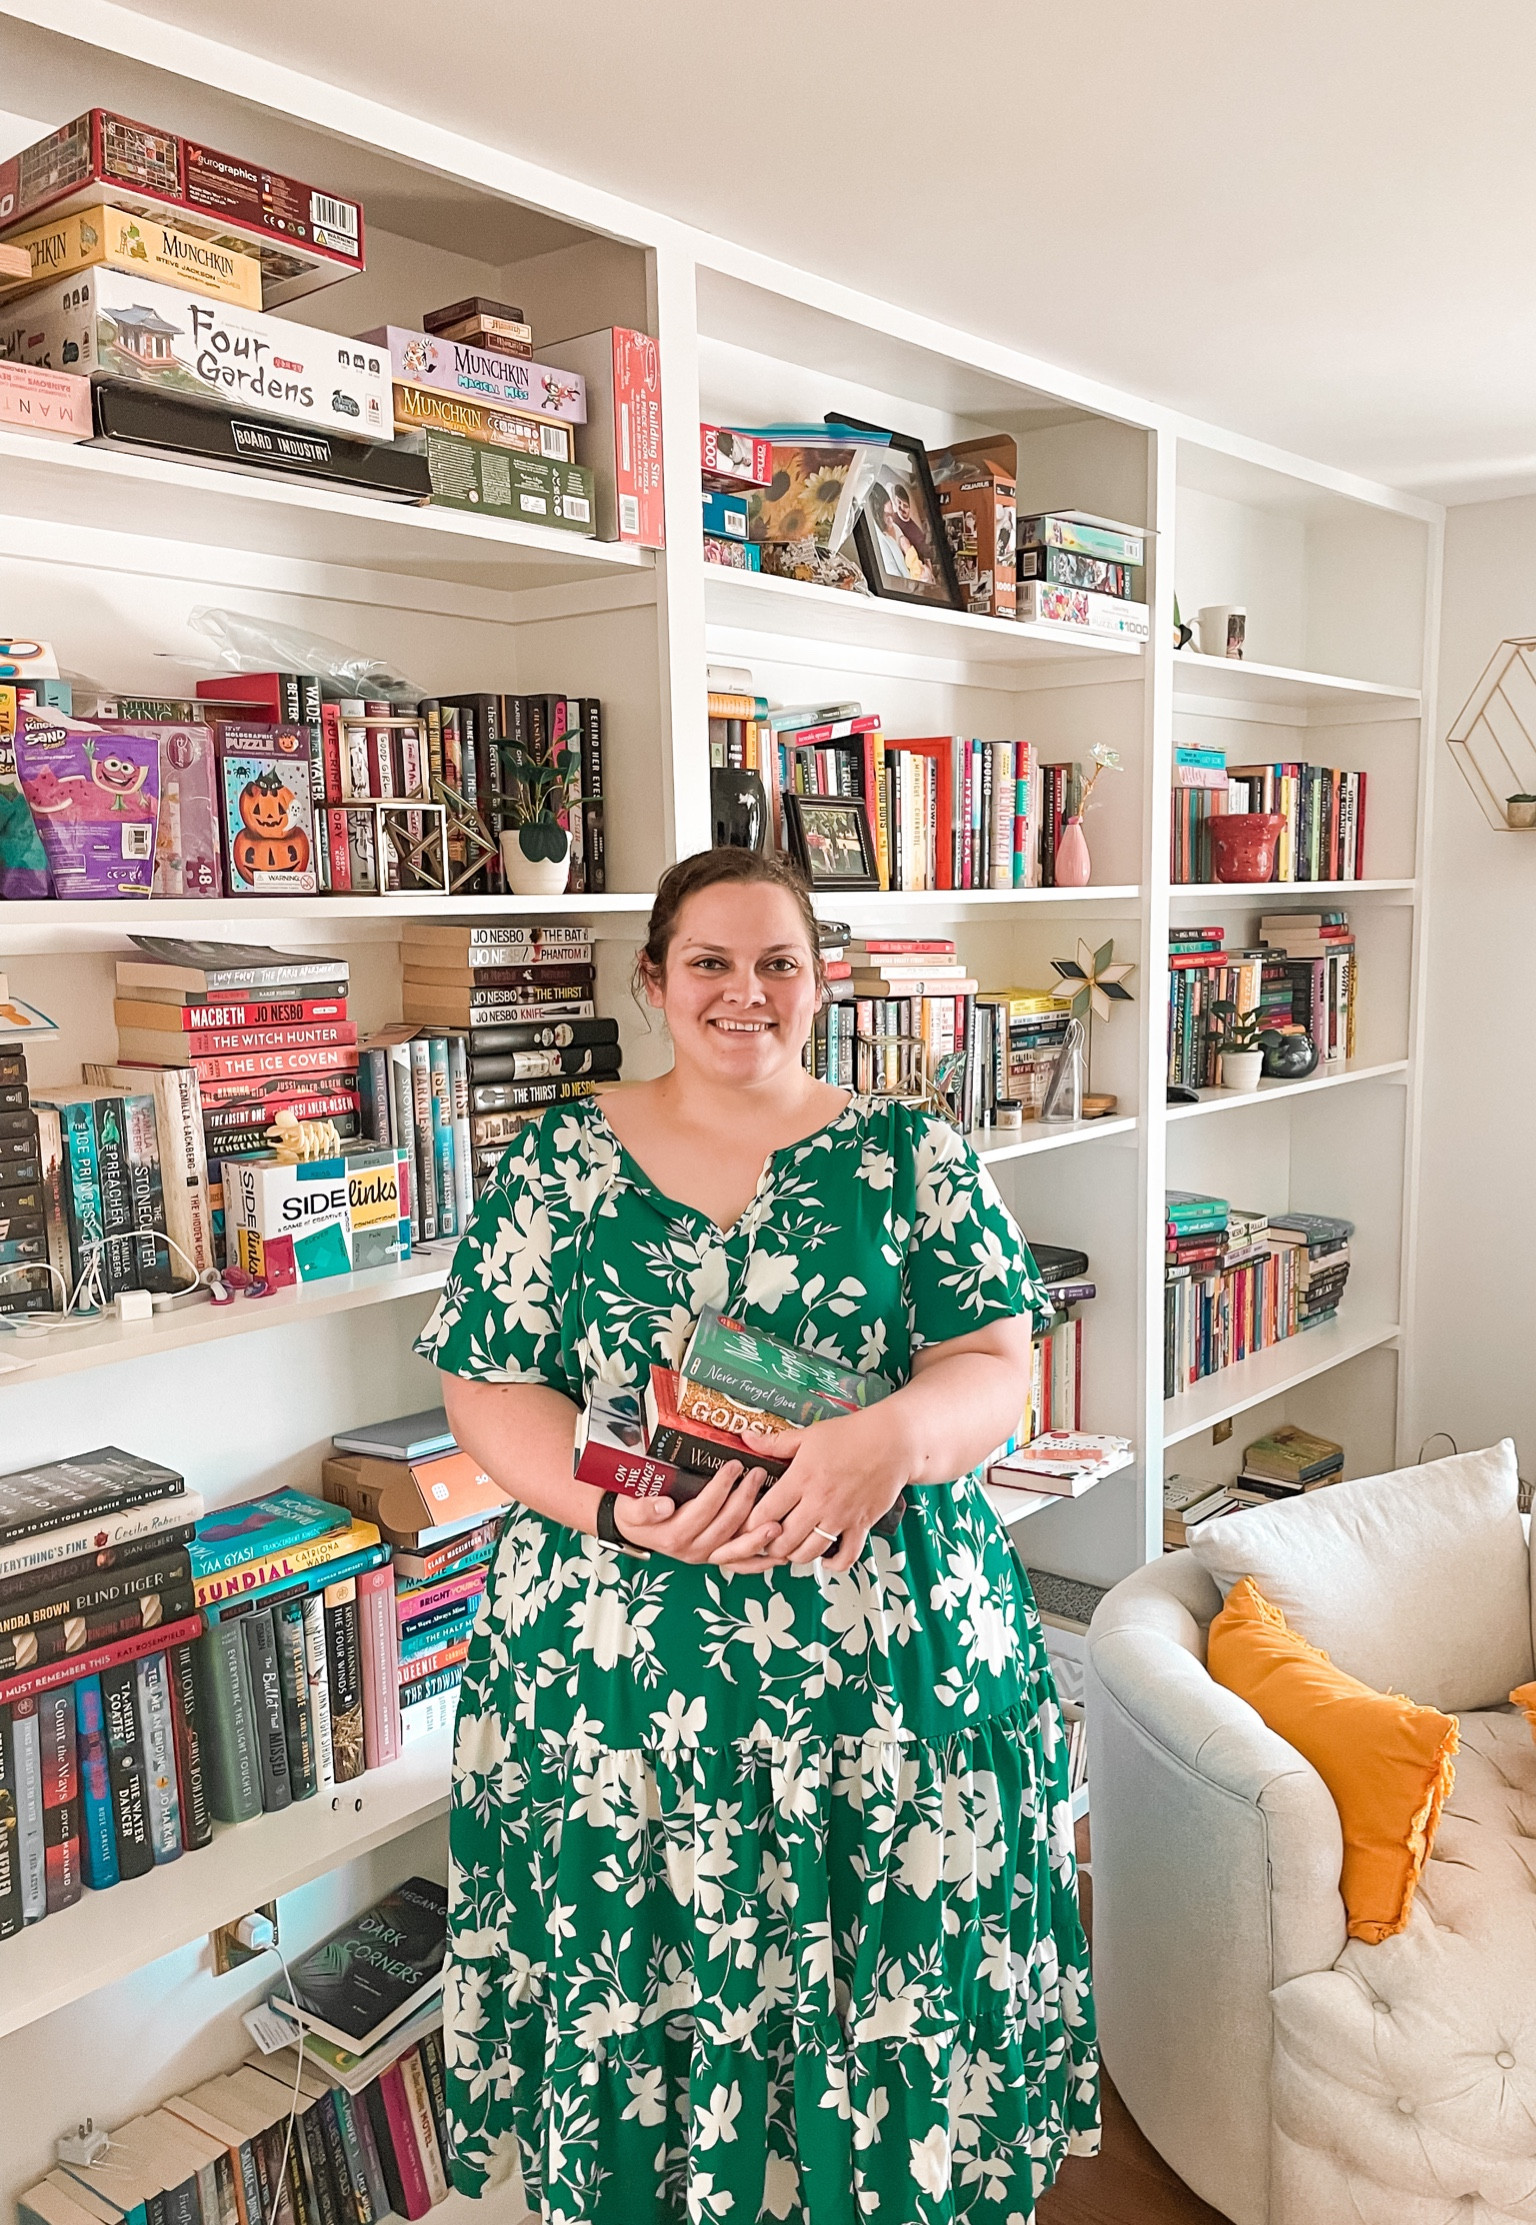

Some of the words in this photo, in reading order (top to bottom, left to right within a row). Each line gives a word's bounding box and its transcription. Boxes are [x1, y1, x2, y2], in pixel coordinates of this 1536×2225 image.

[156, 256, 180, 268] STEVE
[182, 264, 216, 281] JACKSON
[162, 230, 234, 277] MUNCHKIN
[187, 304, 270, 362] Four
[197, 350, 314, 407] Gardens
[454, 346, 529, 388] MUNCHKIN
[458, 374, 500, 394] MAGICAL
[403, 387, 482, 431] MUNCHKIN
[236, 429, 272, 450] BOARD
[278, 438, 329, 462] INDUSTRY
[649, 401, 659, 459] Building
[705, 430, 717, 467] 1000
[651, 462, 660, 488] Site
[1125, 622, 1149, 636] 1000
[287, 682, 298, 720] BETTER
[305, 685, 320, 724] WADE
[225, 738, 274, 751] PUZZLE
[326, 711, 336, 746] TRUE
[590, 708, 599, 747] BEHIND
[310, 757, 325, 801] WATER
[329, 750, 340, 791] CRIME
[592, 751, 600, 773] HER
[983, 748, 992, 796] SPOOKED
[592, 775, 601, 799] EYES
[964, 778, 972, 865] HYSTERICAL
[199, 864, 213, 885] 48
[474, 930, 488, 943] JO
[543, 929, 562, 942] THE
[564, 928, 582, 941] BAT
[472, 948, 489, 965] JO
[541, 947, 582, 960] PHANTOM
[213, 972, 232, 986] LUCY
[260, 969, 275, 983] THE
[473, 992, 487, 1006] JO
[535, 988, 553, 1000] THE
[553, 986, 583, 999] THIRST
[190, 1006, 245, 1027] MACBETH
[254, 1006, 268, 1022] JO
[476, 1010, 488, 1023] JO
[520, 1008, 545, 1020] KNIFE
[212, 1034, 239, 1048] THE
[241, 1030, 283, 1046] WITCH
[287, 1029, 338, 1044] HUNTER
[225, 1059, 255, 1073] THE
[260, 1056, 284, 1070] ICE
[288, 1051, 339, 1067] COVEN
[415, 1067, 428, 1143] DARKNESS
[513, 1087, 529, 1104] THE
[530, 1084, 557, 1101] THIRST
[560, 1083, 571, 1098] JO
[224, 1112, 249, 1125] ABSENT
[251, 1108, 266, 1122] ONE
[485, 1121, 501, 1139] The
[76, 1131, 90, 1154] ICE
[178, 1083, 189, 1119] CAMILLA
[194, 1213, 203, 1241] HIDDEN
[78, 1157, 97, 1228] PRINCESS
[106, 1152, 124, 1226] PREACHER
[243, 1170, 257, 1228] SIDE
[282, 1189, 347, 1221] SIDE
[349, 1174, 397, 1208] links
[134, 1166, 156, 1269] STONECUTTER
[247, 1229, 260, 1275] links
[703, 1364, 737, 1386] Never
[739, 1377, 776, 1403] Forget
[614, 1464, 628, 1482] ON
[624, 1468, 641, 1488] THE
[634, 1462, 656, 1498] SAVAGE
[648, 1474, 666, 1497] SIDE
[6, 1528, 24, 1538] HOW
[27, 1524, 37, 1532] TO
[40, 1518, 58, 1529] LOVE
[61, 1512, 81, 1522] YOUR
[83, 1501, 120, 1516] DAUGHTER
[126, 1495, 143, 1504] HILA
[145, 1488, 163, 1498] BLUM
[66, 1539, 88, 1555] FINE
[114, 1522, 149, 1541] Cecilia
[123, 1545, 143, 1557] SIAN
[144, 1535, 175, 1550] GILBERT
[198, 1559, 294, 1606] SUNDIAL
[295, 1541, 340, 1563] CATRIONA
[200, 1559, 221, 1575] YAA
[224, 1546, 254, 1566] GYASI
[306, 1552, 332, 1568] WARD
[427, 1554, 446, 1570] CLARE
[33, 1600, 70, 1622] BROWN
[76, 1586, 120, 1610] BLIND
[122, 1572, 164, 1597] TIGER
[419, 1588, 451, 1608] BRIGHT
[450, 1580, 481, 1597] YOUNG
[334, 1608, 343, 1630] THE
[345, 1606, 355, 1645] KRISTIN
[406, 1623, 416, 1633] You
[418, 1617, 432, 1628] Were
[432, 1612, 452, 1625] Always
[452, 1605, 466, 1616] Mine
[425, 1631, 441, 1644] THE
[442, 1623, 464, 1638] HALF
[335, 1631, 345, 1658] FOUR
[5, 1681, 33, 1699] MUST
[35, 1663, 87, 1687] REMEMBER
[89, 1655, 111, 1669] THIS
[147, 1667, 158, 1690] TELL
[227, 1648, 241, 1708] EVERYTHING
[336, 1659, 348, 1695] WINDS
[347, 1646, 357, 1690] HANNAH
[150, 1693, 162, 1711] ME
[181, 1665, 195, 1716] LIONESS
[262, 1672, 280, 1710] Bullet
[404, 1683, 424, 1706] THE
[53, 1698, 67, 1744] Count
[109, 1694, 124, 1741] COATES
[120, 1682, 135, 1744] TA-NEHISI
[152, 1717, 162, 1730] AN
[234, 1707, 244, 1725] THE
[153, 1731, 166, 1774] ENDING
[237, 1726, 247, 1754] LIGHT
[268, 1732, 288, 1777] MISSED
[54, 1760, 70, 1801] Ways
[129, 1774, 140, 1796] THE
[60, 1808, 70, 1839] JOYCE
[118, 1789, 133, 1837] DANCER
[131, 1796, 145, 1844] WATER
[160, 1804, 174, 1852] HARKIN
[62, 1840, 72, 1887] MAYNARD
[397, 1888, 438, 1911] MEGAN
[358, 1917, 407, 1948] DARK
[343, 1939, 424, 1985] CORNERS
[420, 2110, 433, 2148] MOTEL
[240, 2146, 252, 2188] SALVAGE
